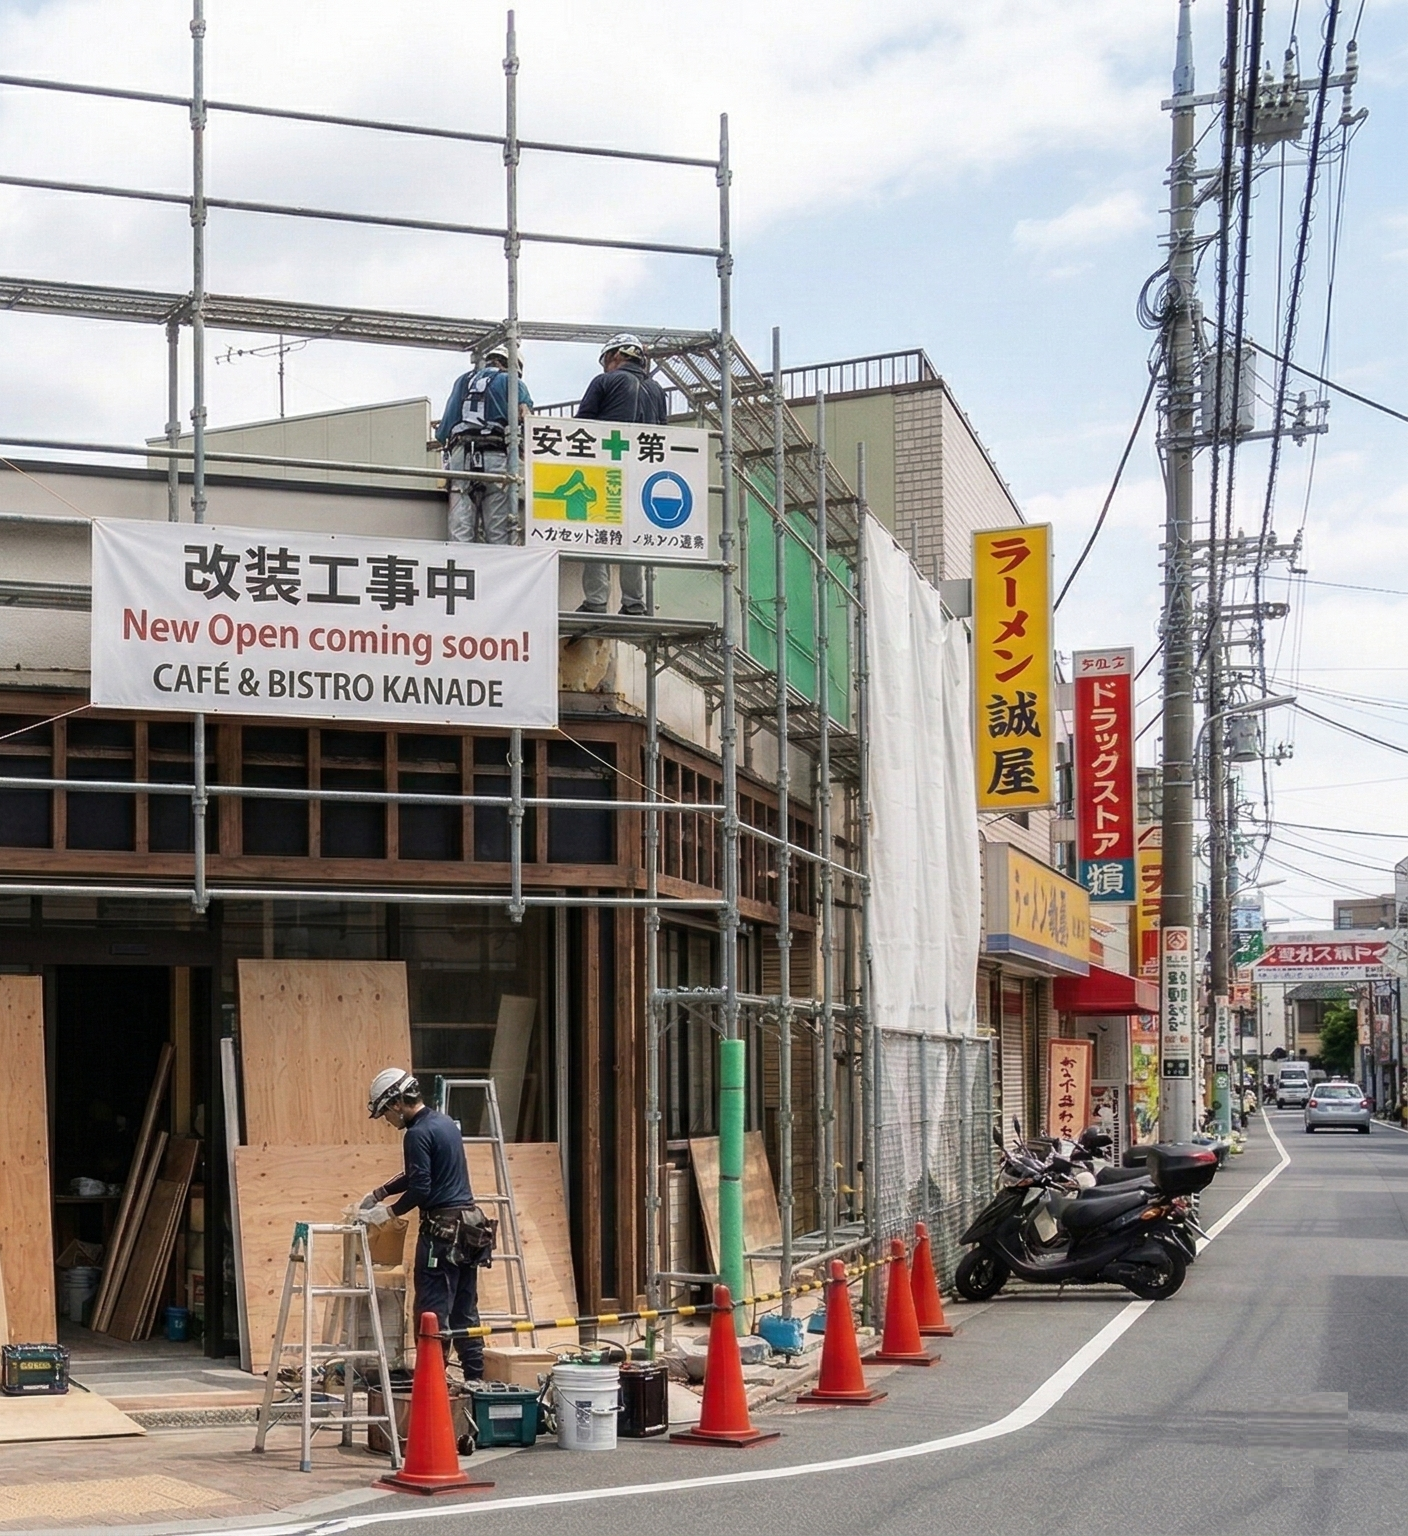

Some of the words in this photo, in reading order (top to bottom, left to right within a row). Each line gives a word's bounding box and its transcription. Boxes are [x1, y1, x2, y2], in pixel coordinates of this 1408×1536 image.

[532, 425, 597, 459] 安全
[637, 432, 699, 463] 第一
[183, 543, 476, 615] 改装工事中
[123, 608, 199, 643] New
[208, 613, 299, 654] Open
[309, 624, 433, 665] coming
[443, 631, 530, 662] soon!
[153, 661, 230, 695] CAFÉ
[238, 669, 260, 697] &
[268, 670, 374, 702] BISTRO
[383, 676, 503, 708] KANADE
[1089, 681, 1120, 856] ドラッグストア
